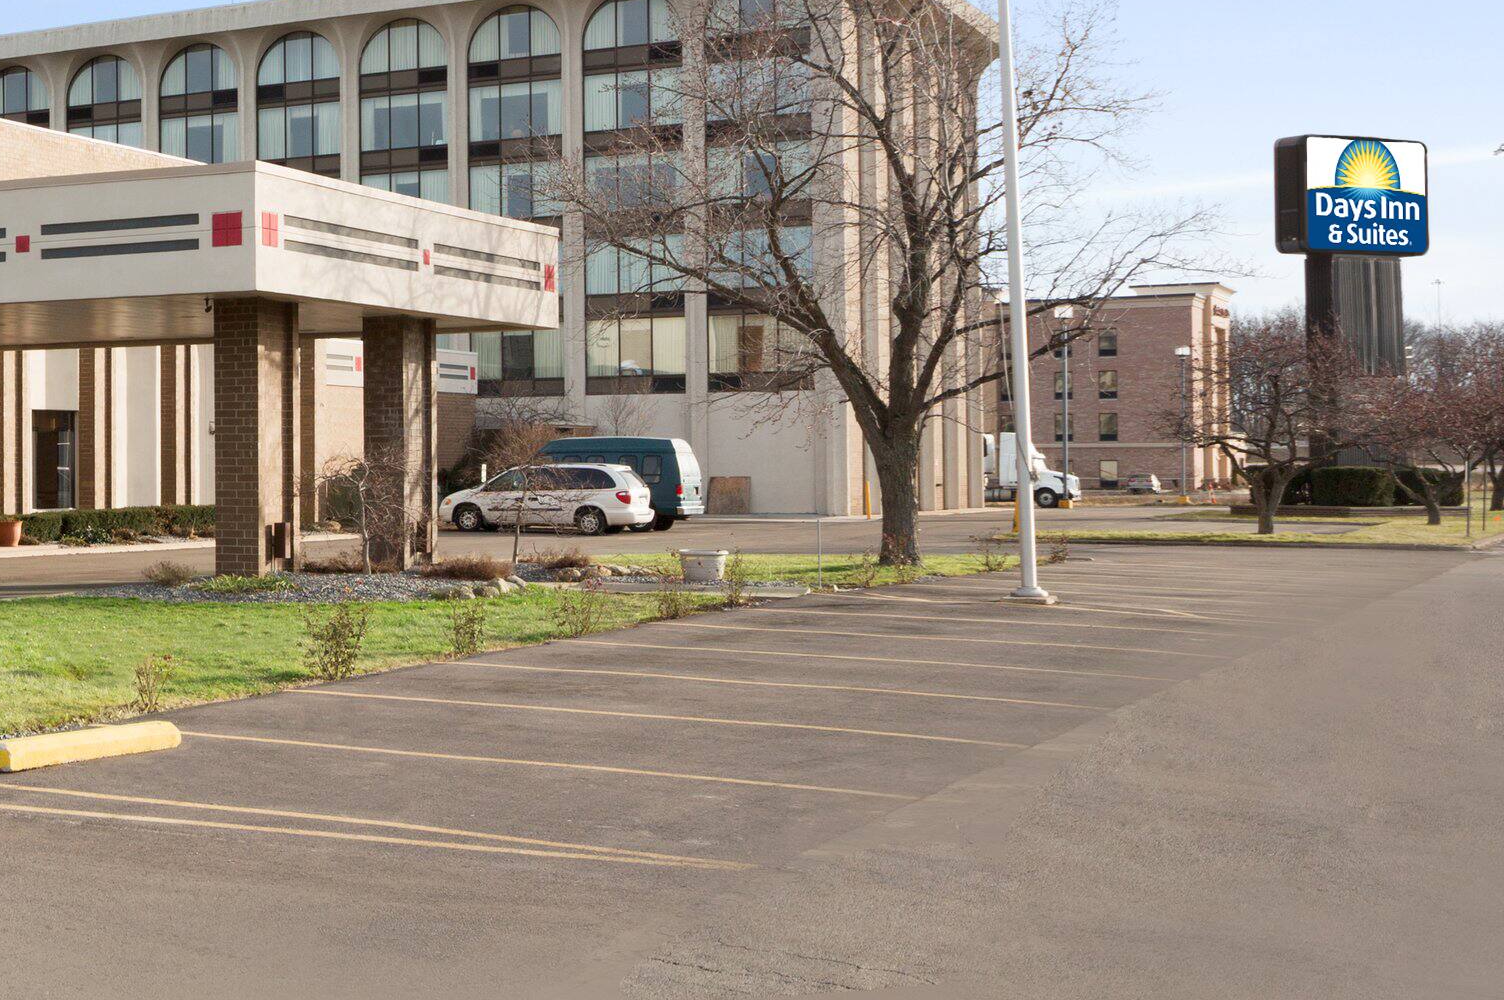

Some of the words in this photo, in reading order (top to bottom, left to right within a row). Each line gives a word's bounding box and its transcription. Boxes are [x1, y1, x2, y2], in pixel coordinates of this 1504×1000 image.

[1315, 192, 1377, 221] Days
[1381, 196, 1420, 221] Inn
[1328, 223, 1343, 244] &
[1346, 222, 1409, 246] Suites
